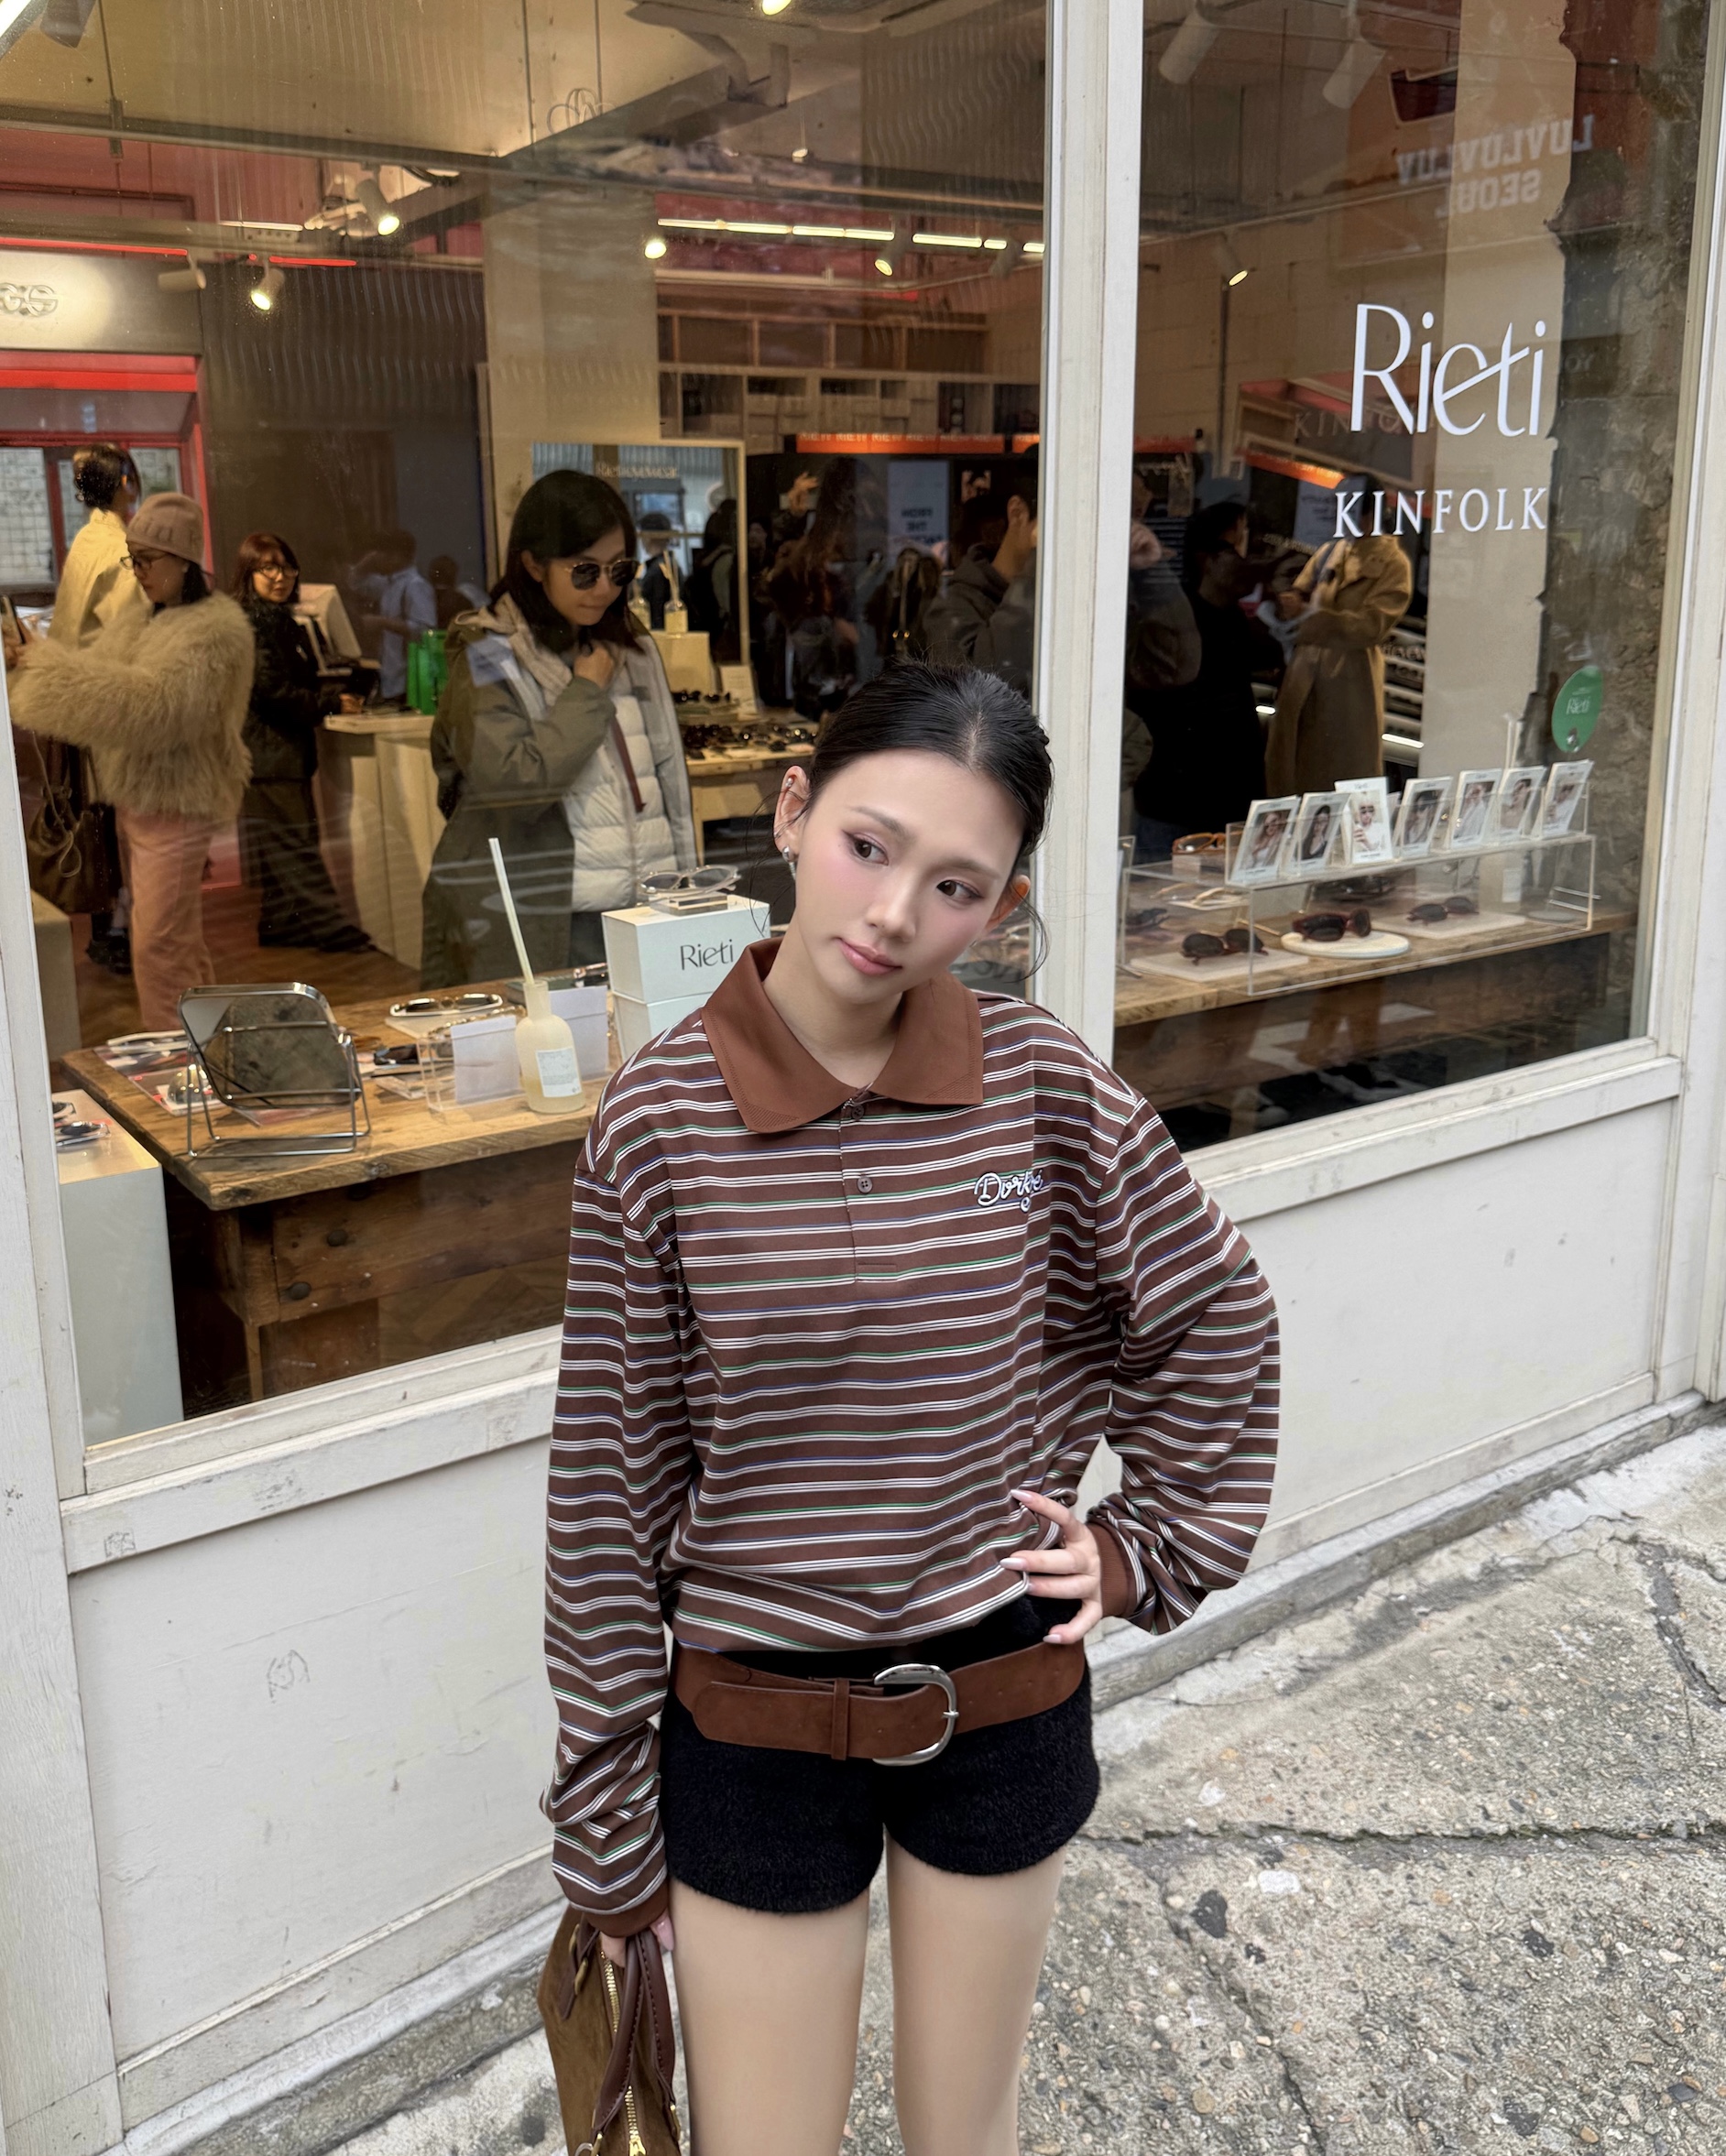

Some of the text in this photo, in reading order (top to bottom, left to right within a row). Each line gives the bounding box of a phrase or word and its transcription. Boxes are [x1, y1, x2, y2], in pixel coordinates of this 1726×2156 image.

[1350, 303, 1546, 437] Rieti
[1333, 487, 1548, 539] KINFOLK
[680, 939, 734, 971] Rieti
